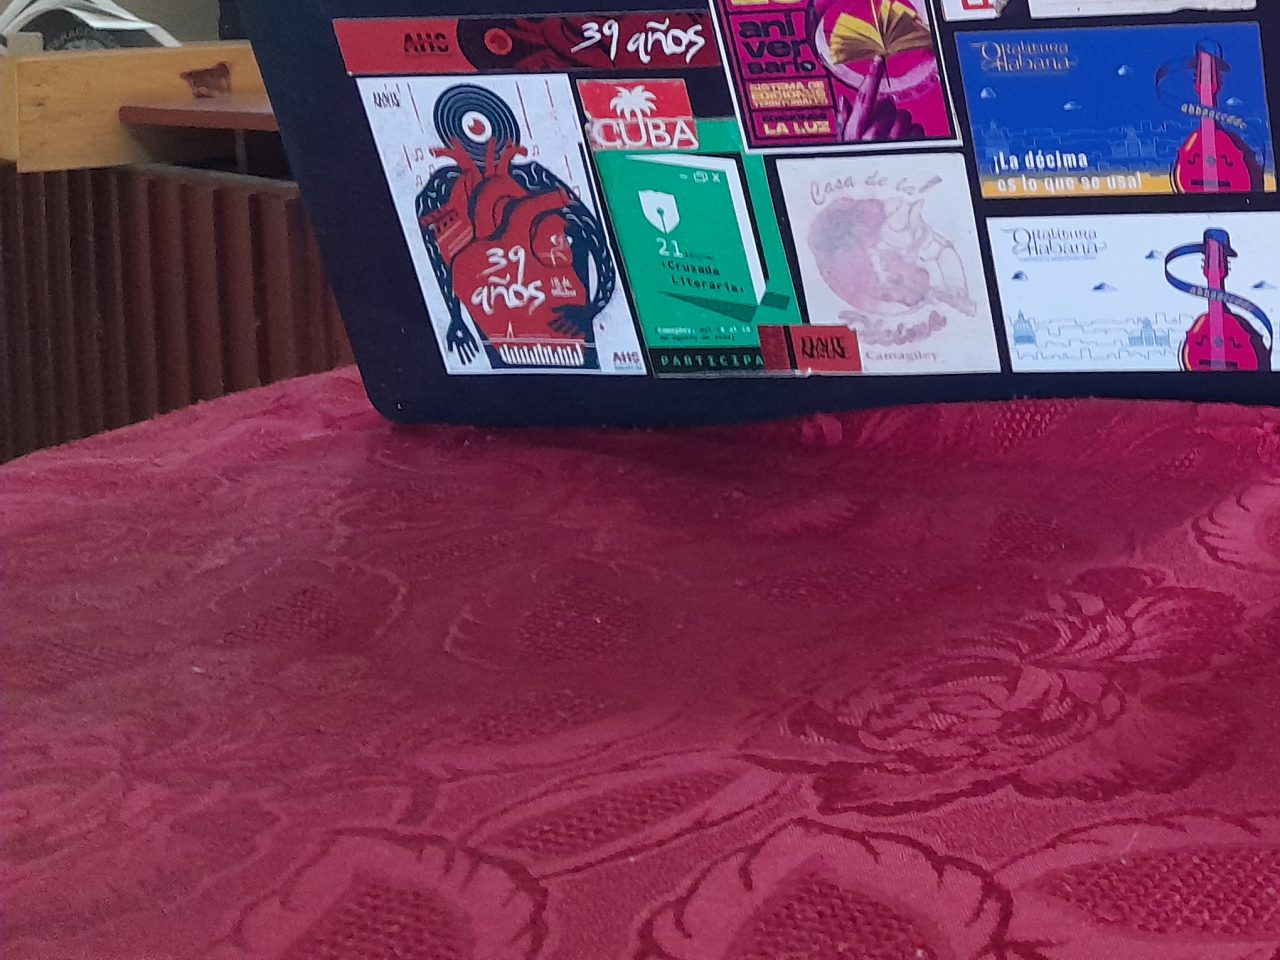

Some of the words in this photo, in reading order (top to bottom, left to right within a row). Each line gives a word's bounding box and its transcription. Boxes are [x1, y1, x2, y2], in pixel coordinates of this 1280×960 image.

[739, 13, 796, 39] ani
[570, 20, 620, 62] 39
[626, 18, 706, 64] años
[743, 40, 809, 59] ver
[591, 118, 700, 150] CUBA
[763, 122, 789, 136] LA
[793, 120, 831, 136] LUZ
[1025, 149, 1088, 171] décima
[810, 175, 855, 206] Casa
[865, 171, 888, 187] de
[997, 177, 1016, 193] es
[1022, 174, 1037, 192] lo
[1044, 176, 1075, 194] que
[1080, 175, 1100, 190] se
[656, 237, 684, 259] 21
[476, 246, 526, 287] 39
[471, 273, 546, 316] años
